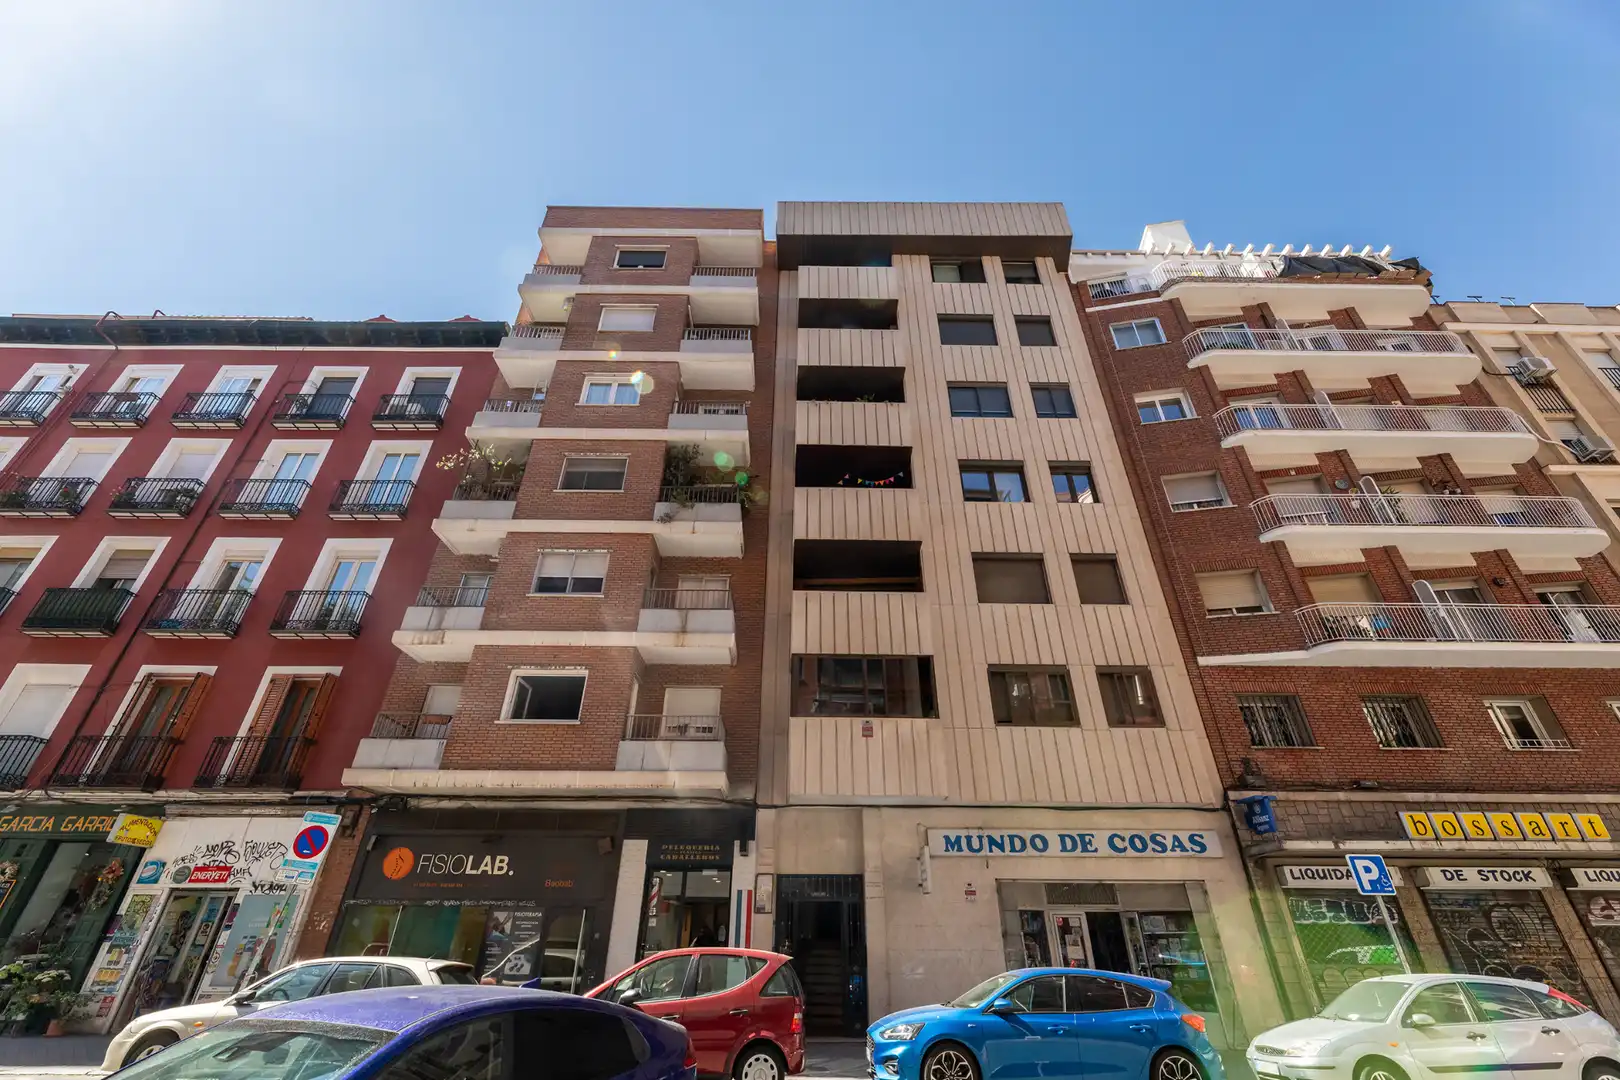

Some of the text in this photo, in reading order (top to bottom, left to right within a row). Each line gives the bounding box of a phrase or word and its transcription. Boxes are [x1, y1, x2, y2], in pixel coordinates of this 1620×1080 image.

[0, 815, 55, 831] GARCIA
[1408, 814, 1602, 837] bossart
[943, 833, 1208, 854] MUNDO DE COSAS
[191, 871, 228, 882] ENERYETI
[1354, 859, 1380, 890] P
[1440, 869, 1537, 883] DE STOCK
